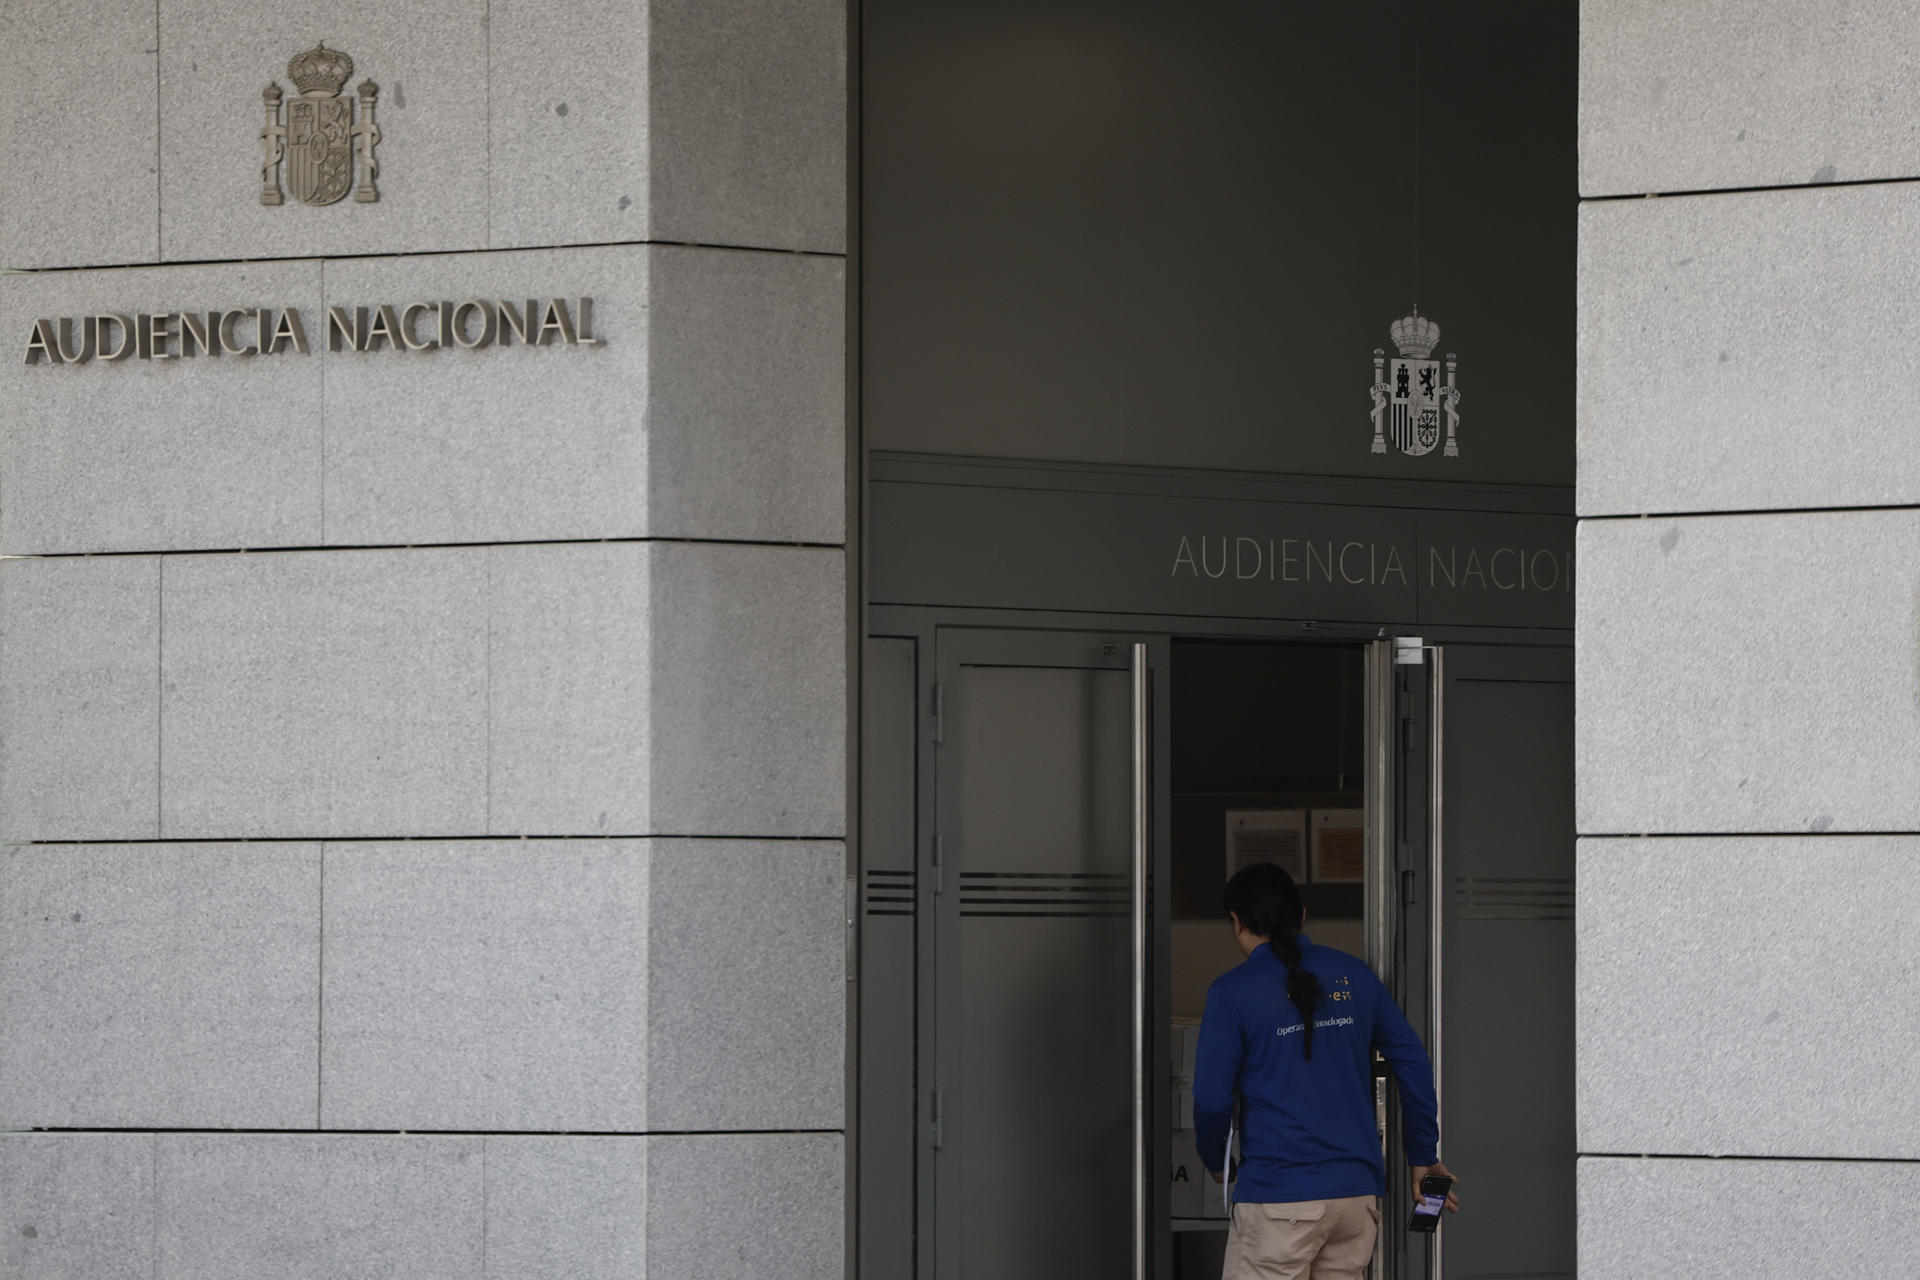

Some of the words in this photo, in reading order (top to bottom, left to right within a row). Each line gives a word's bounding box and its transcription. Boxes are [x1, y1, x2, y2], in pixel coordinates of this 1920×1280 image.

[24, 307, 310, 364] AUDIENCIA
[327, 297, 606, 352] NACIONAL
[1172, 534, 1407, 586] AUDIENCIA
